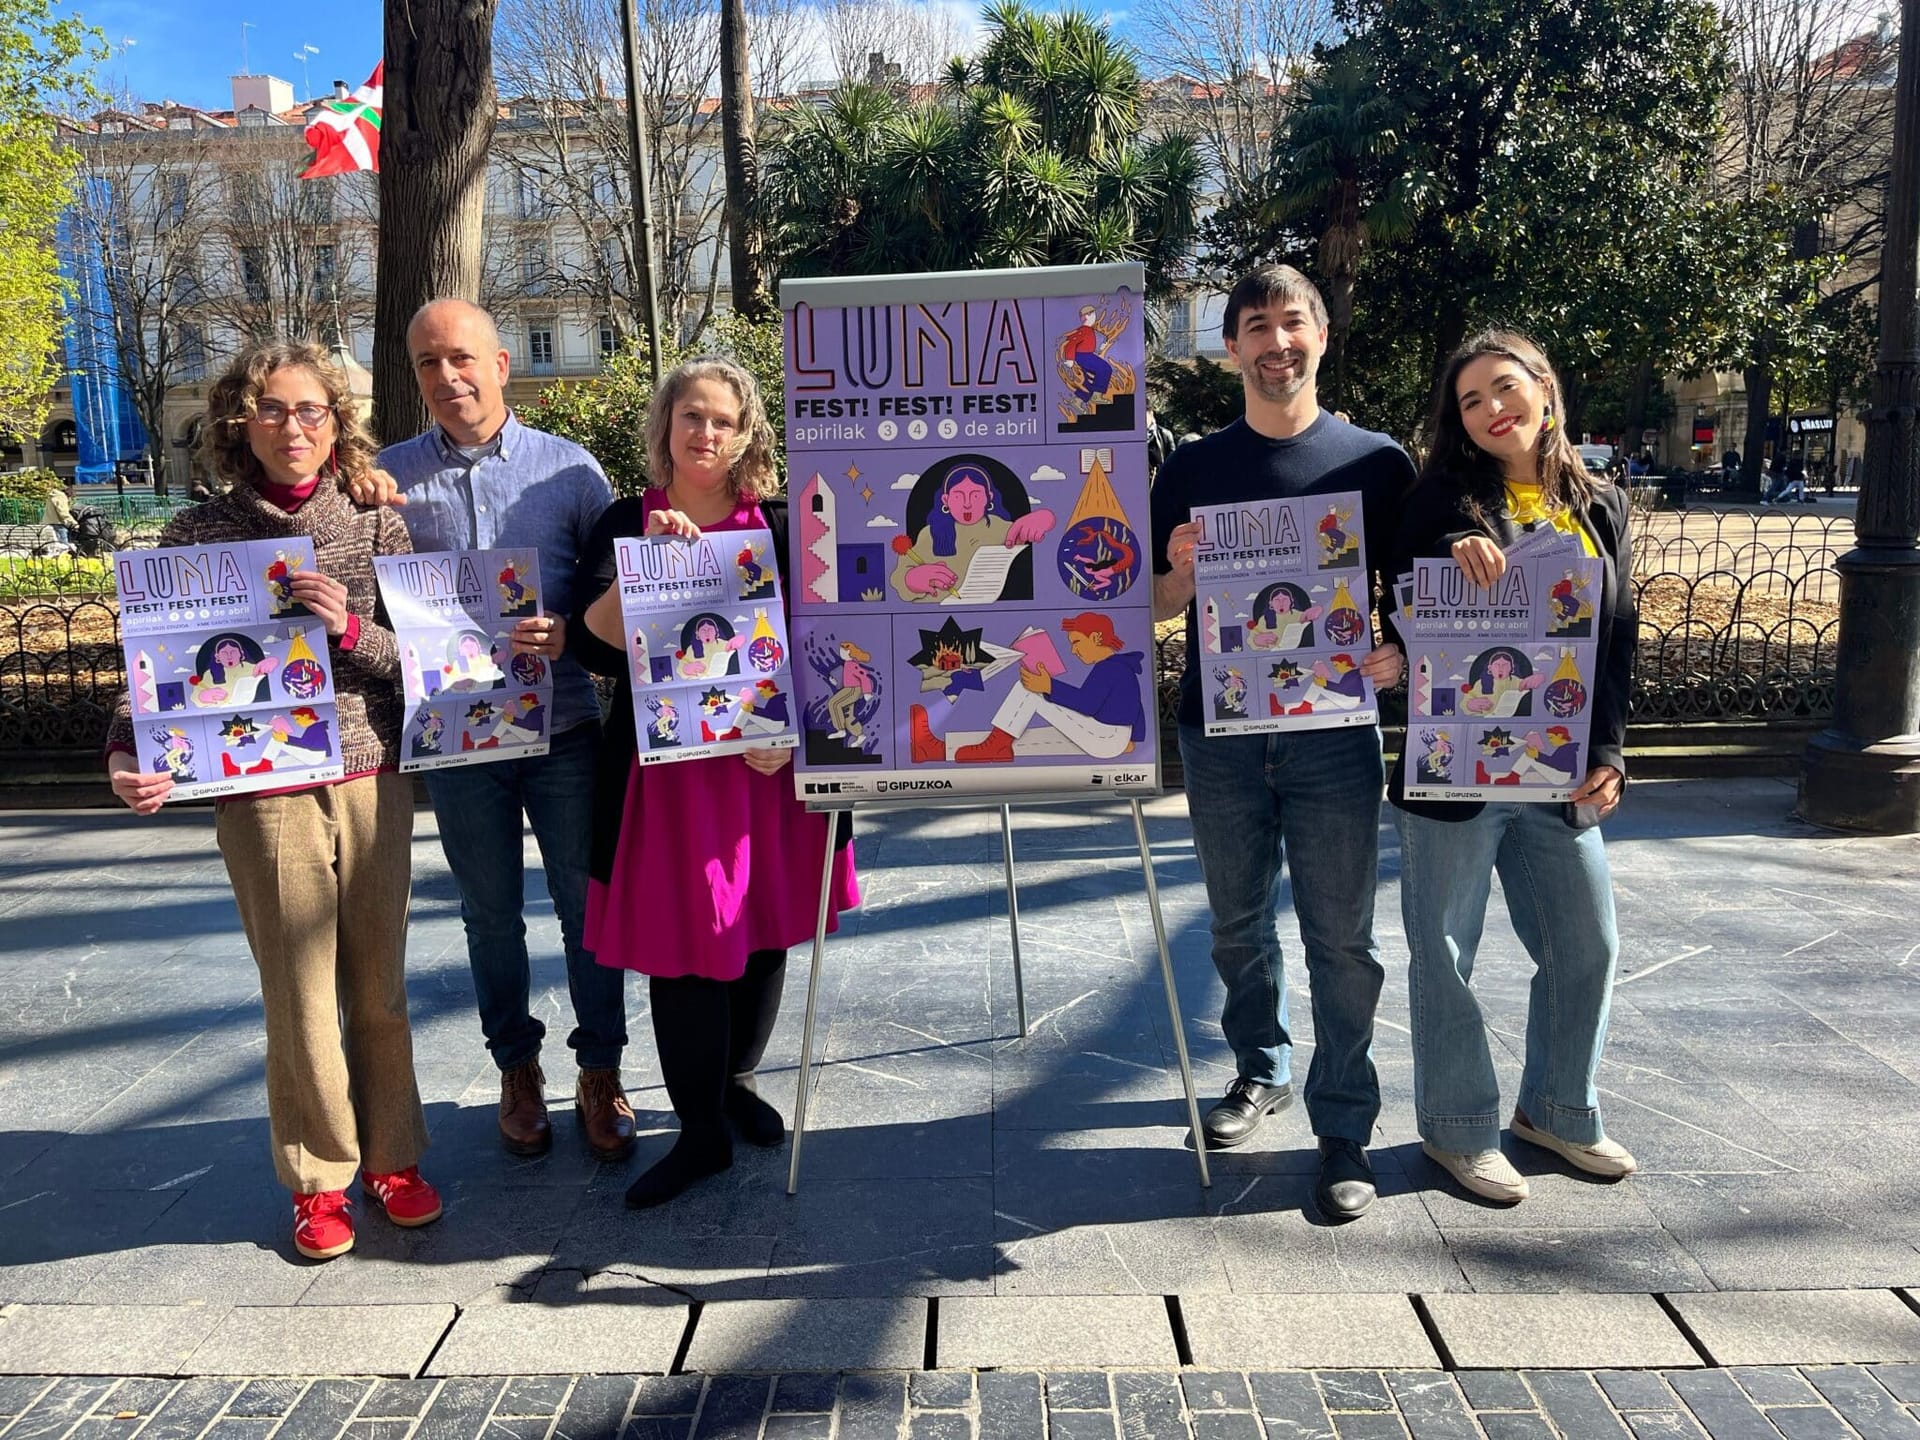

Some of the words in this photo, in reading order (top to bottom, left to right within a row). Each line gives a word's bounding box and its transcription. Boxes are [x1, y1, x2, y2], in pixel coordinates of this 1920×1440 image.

[795, 299, 1037, 391] LUMA
[795, 398, 869, 419] FEST!
[879, 395, 953, 417] FEST!
[963, 393, 1037, 414] FEST!
[795, 421, 866, 442] apirilak
[881, 422, 895, 438] 3
[911, 422, 925, 437] 4
[941, 421, 955, 436] 5
[965, 420, 988, 437] de
[995, 419, 1037, 437] abril
[1196, 506, 1301, 552] LUMA
[620, 540, 721, 583] LUMA
[1198, 553, 1230, 563] FEST!
[1233, 549, 1265, 560] FEST!
[1269, 546, 1301, 557] FEST!
[120, 551, 247, 602] LUMA
[624, 584, 655, 594] FEST!
[658, 581, 689, 591] FEST!
[692, 578, 722, 588] FEST!
[126, 603, 164, 614] FEST!
[169, 599, 206, 610] FEST!
[211, 594, 248, 606] FEST!
[425, 598, 449, 608] EST!
[452, 595, 483, 606] FEST!
[213, 608, 225, 617] de
[228, 606, 250, 616] abril
[1416, 610, 1450, 618] FEST!
[1455, 610, 1489, 618] FEST!
[1494, 609, 1529, 618] FEST!
[889, 780, 953, 792] GIPUZKOA
[1114, 773, 1147, 783] elkar
